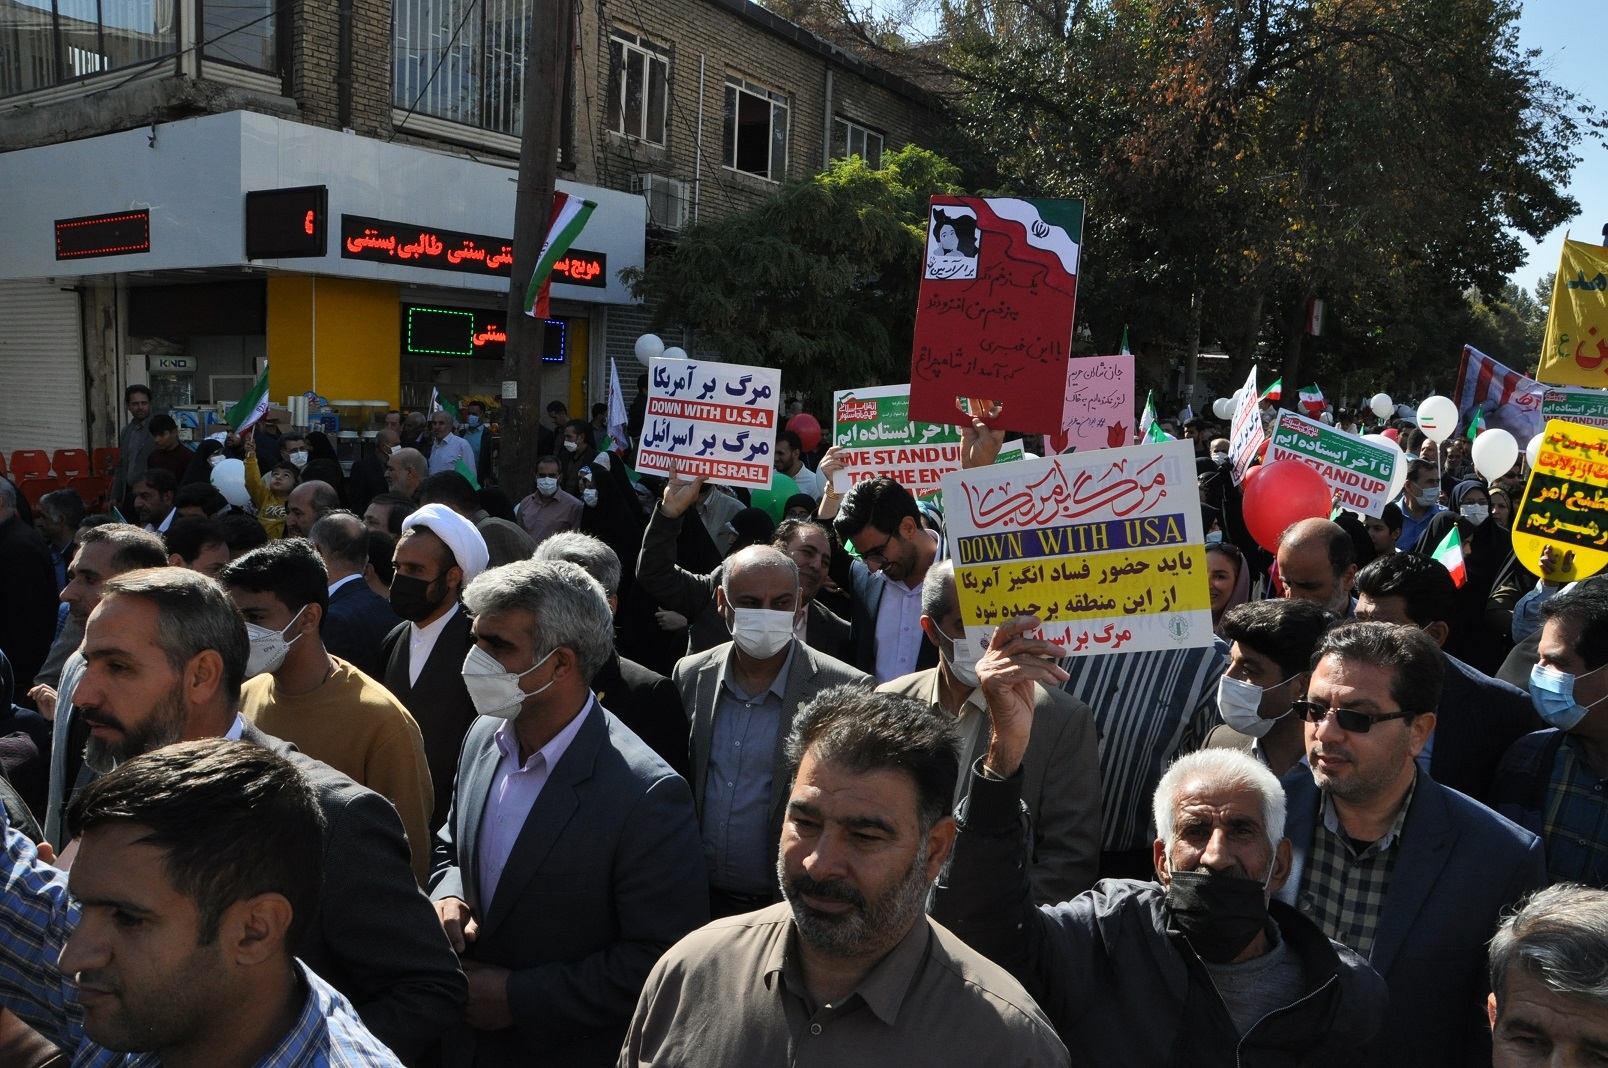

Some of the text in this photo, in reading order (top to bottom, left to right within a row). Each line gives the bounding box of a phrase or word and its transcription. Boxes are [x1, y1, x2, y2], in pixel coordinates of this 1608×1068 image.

[347, 229, 396, 256] بستنی
[397, 233, 443, 259] طالبی
[447, 240, 485, 264] سنتی
[570, 258, 600, 280] هویج
[653, 365, 772, 405] مرگ بر آمریکا
[651, 400, 768, 425] DOWN WITH U.S.A
[1555, 403, 1585, 415] ایستاده
[1560, 415, 1594, 425] STAND
[1594, 418, 1608, 427] UP
[1585, 404, 1603, 416] آخر
[643, 418, 769, 461] مرگ بر اسرائیل
[837, 423, 858, 448] ایم
[860, 421, 915, 444] ایستاده
[1275, 433, 1298, 448] ایم
[873, 447, 941, 465] STAND
[1298, 438, 1348, 464] ایستاده
[640, 452, 767, 481] DOWN WITH ISRAEL
[1346, 456, 1379, 471] آخر
[1379, 463, 1391, 476] تا
[1360, 477, 1386, 495] UP
[1532, 482, 1608, 513] طیع امر
[959, 516, 1184, 563] DOWN WITH USA
[962, 551, 1193, 594] باید حضور فساد انگیز آمریکا
[1065, 593, 1117, 612] منطقه
[1122, 590, 1153, 613] این
[1160, 586, 1177, 612] از
[975, 600, 998, 624] شود
[1073, 629, 1090, 652] بر
[1093, 622, 1132, 649] مرگ
